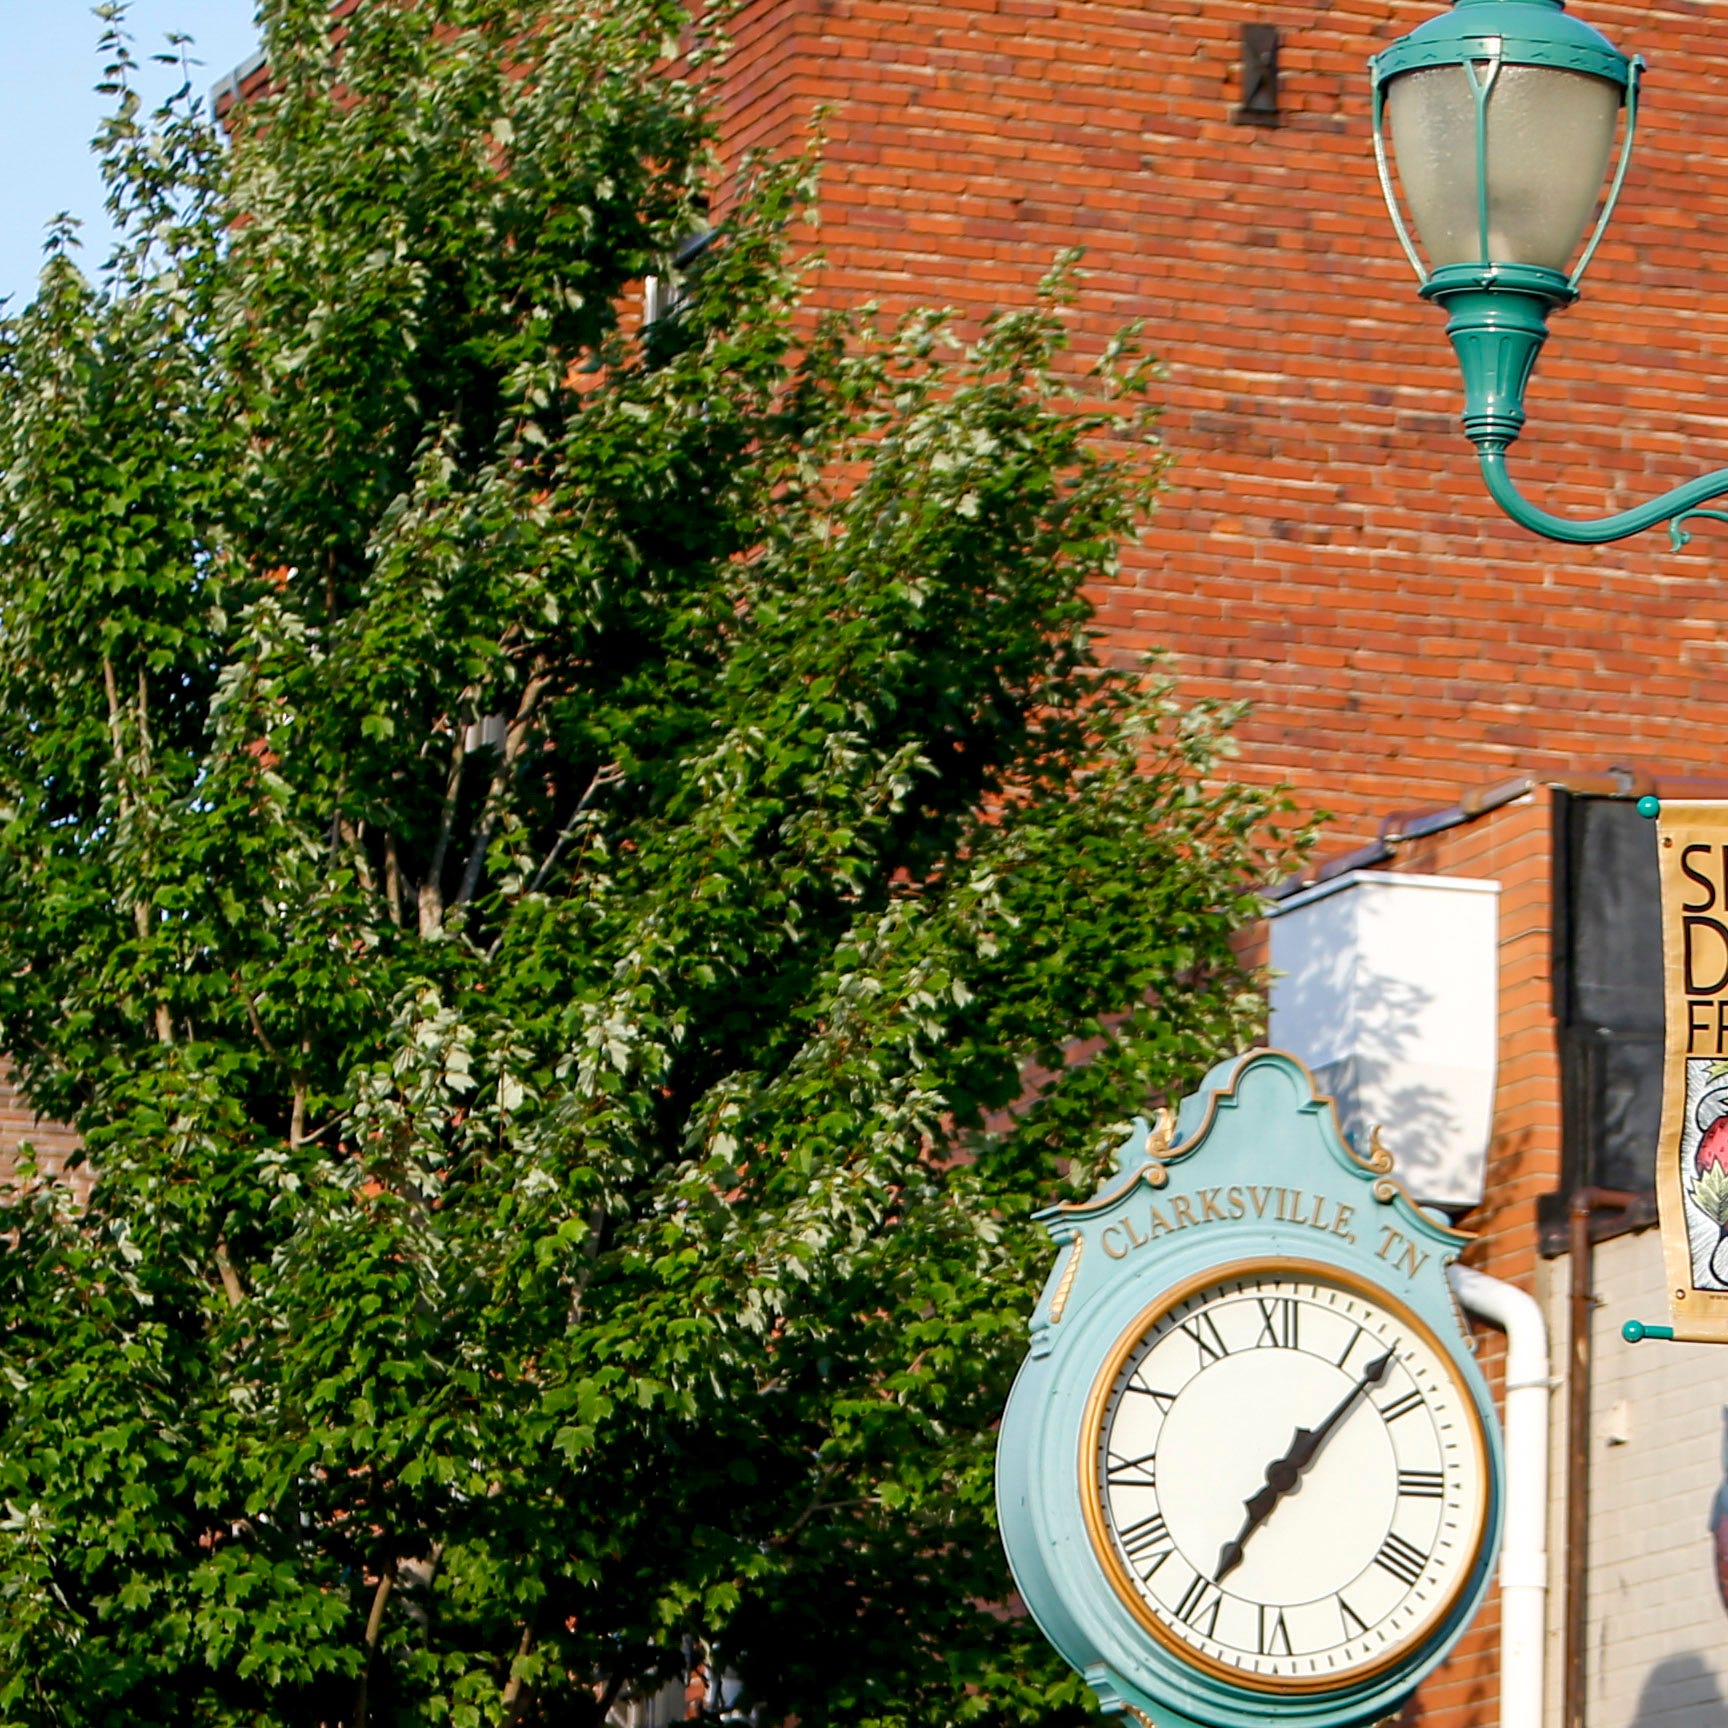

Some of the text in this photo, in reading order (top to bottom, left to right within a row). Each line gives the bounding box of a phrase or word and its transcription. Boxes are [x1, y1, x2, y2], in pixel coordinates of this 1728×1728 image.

[1101, 1185, 1431, 1279] CLARKSVILLE, TN
[1179, 1311, 1230, 1369] XI
[1257, 1299, 1298, 1349] XII
[1338, 1327, 1363, 1368] I
[1127, 1370, 1177, 1415] X
[1381, 1390, 1425, 1422] II
[1107, 1452, 1156, 1487] IX
[1398, 1470, 1444, 1497] III
[1258, 1605, 1292, 1656] VI
[1336, 1592, 1370, 1641] V
